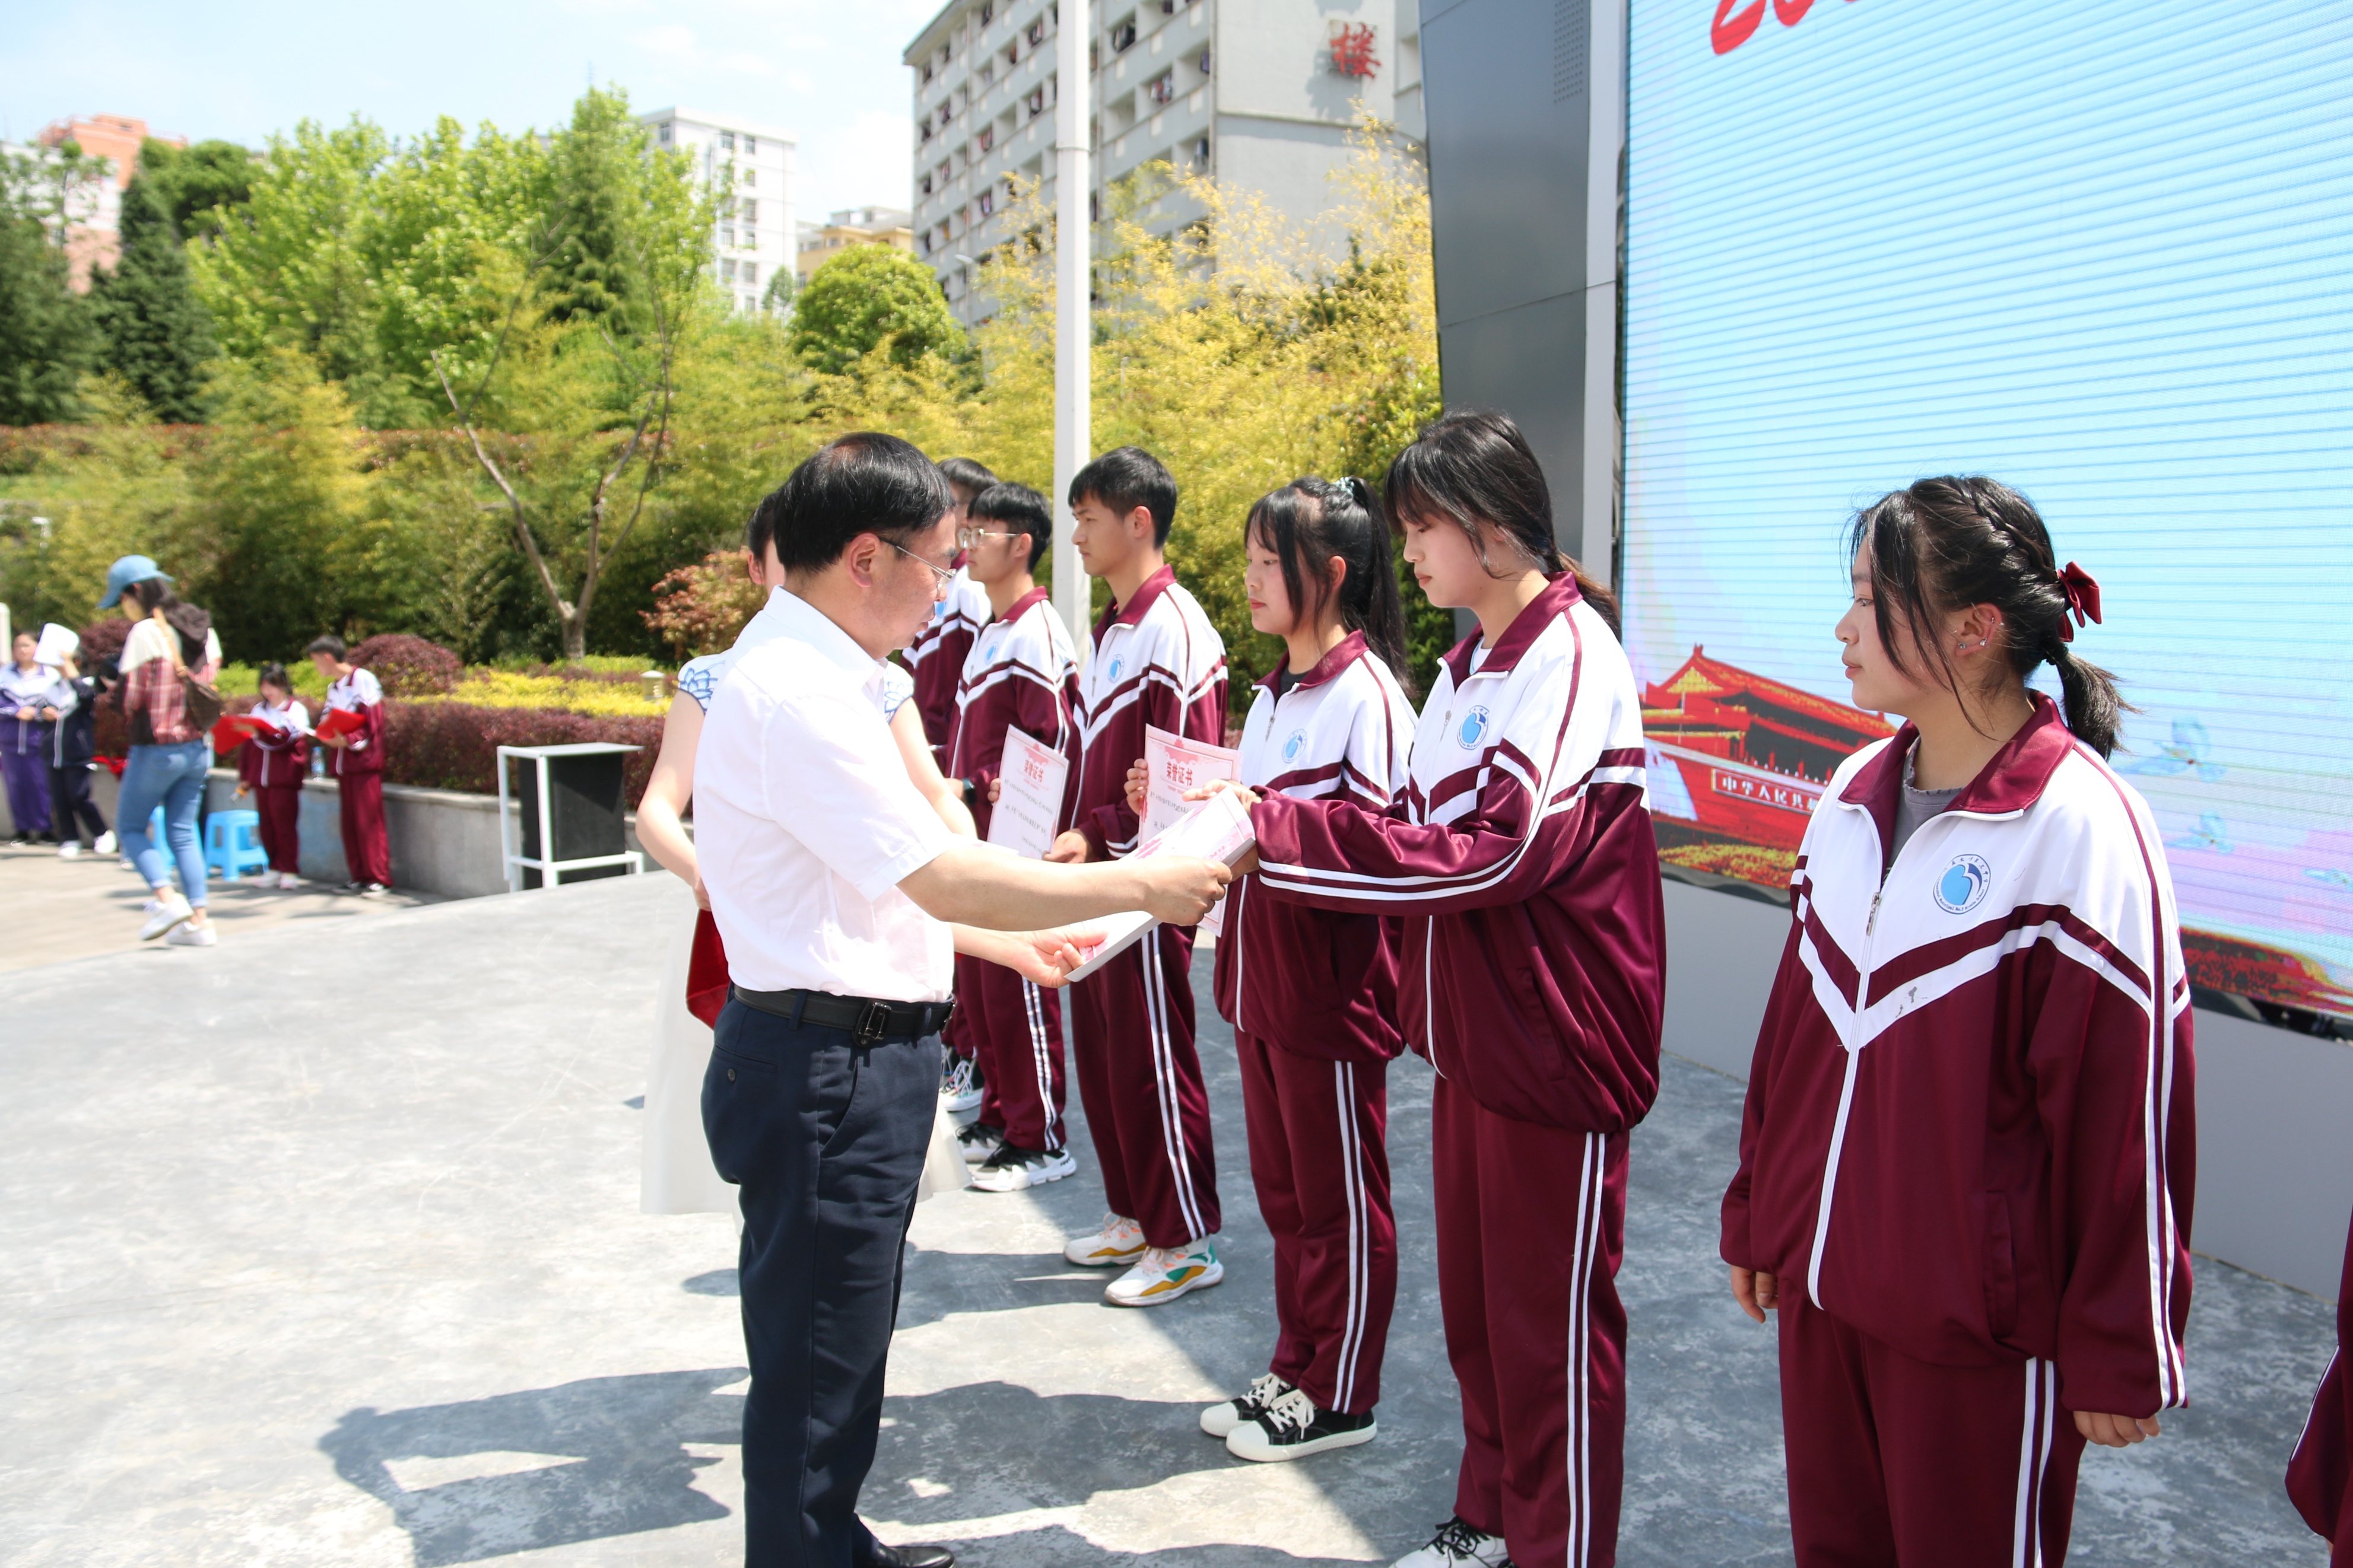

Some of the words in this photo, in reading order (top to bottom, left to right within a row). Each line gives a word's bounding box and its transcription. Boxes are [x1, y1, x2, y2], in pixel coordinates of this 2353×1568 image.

[1329, 21, 1382, 79] 楼
[1023, 759, 1044, 783] 荣誉证书
[1166, 761, 1193, 787] 荣誉证书
